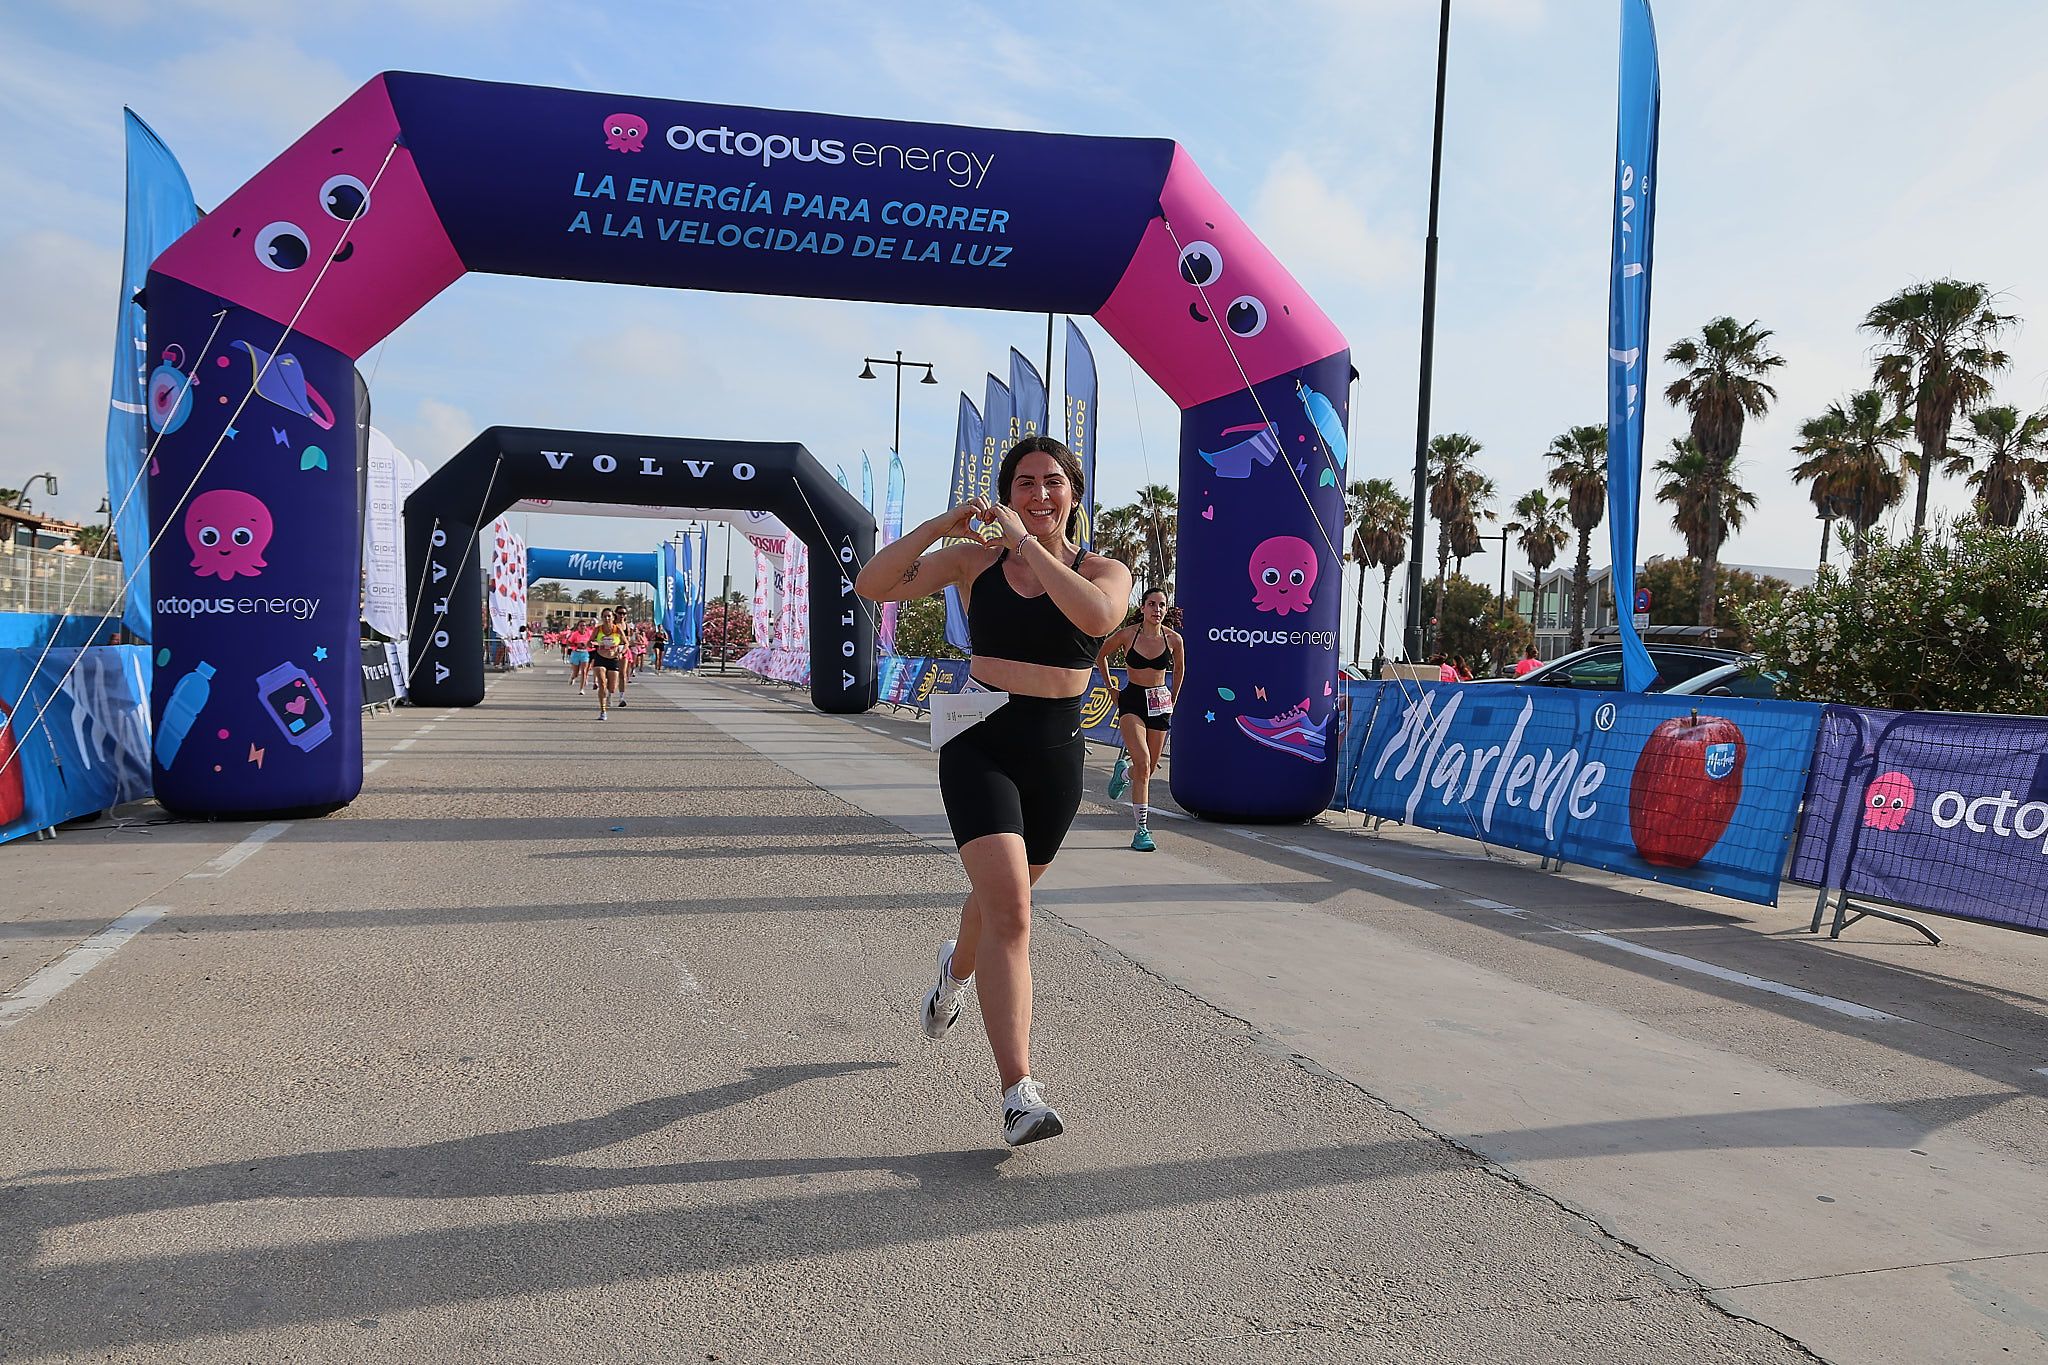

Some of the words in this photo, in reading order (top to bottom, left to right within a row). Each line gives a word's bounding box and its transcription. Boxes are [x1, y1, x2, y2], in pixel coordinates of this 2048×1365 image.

[666, 125, 846, 167] octopus
[852, 142, 995, 189] energy
[573, 172, 616, 200] LA
[626, 177, 772, 214] ENERGÍA
[782, 192, 870, 223] PARA
[881, 201, 1010, 234] CORRER
[568, 210, 592, 234] A
[602, 213, 644, 239] LA
[657, 218, 845, 254] VELOCIDAD
[851, 235, 897, 259] DE
[901, 239, 941, 263] LA
[950, 243, 1013, 268] LUZ
[540, 450, 756, 481] VOLVO
[568, 553, 624, 577] Marlene
[157, 595, 235, 619] octopus
[237, 598, 320, 620] energy
[431, 529, 450, 685] VOLVO
[840, 546, 856, 691] VOLVO
[1208, 626, 1288, 648] octopus
[1290, 631, 1337, 650] energy
[1374, 688, 1607, 841] Marlene
[1931, 790, 2048, 855] octo
